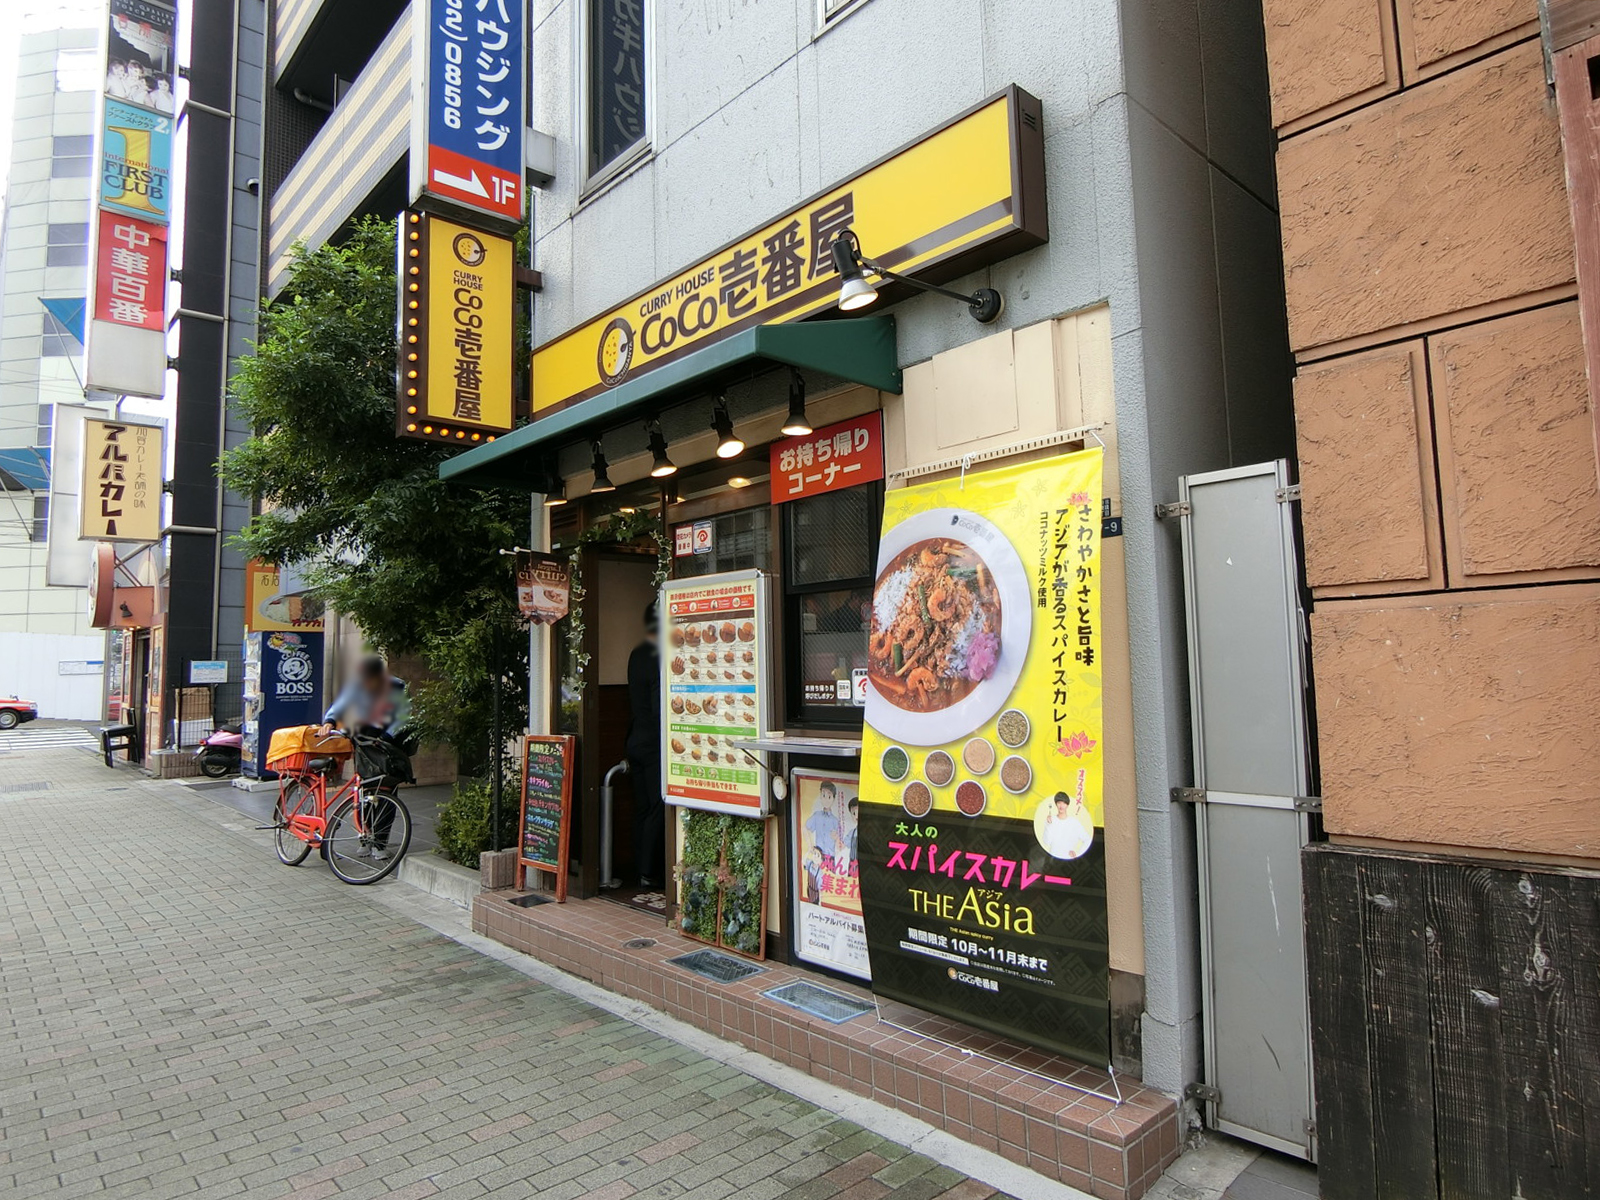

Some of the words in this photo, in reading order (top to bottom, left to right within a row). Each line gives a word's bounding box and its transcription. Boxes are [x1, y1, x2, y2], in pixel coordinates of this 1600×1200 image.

[475, 0, 511, 151] ハウジング
[104, 159, 168, 187] FIRST
[104, 174, 164, 199] CLUB
[491, 175, 516, 205] 1F
[109, 224, 150, 324] 中華百番
[453, 269, 483, 283] CURRY
[453, 276, 483, 291] HOUSE
[639, 288, 674, 318] CURRY
[676, 266, 715, 300] HOUSE
[779, 427, 869, 472] お持ち帰り
[788, 463, 861, 495] コーナー
[1037, 511, 1048, 609] ココナッツミルク使用
[1075, 504, 1095, 667] さわやかさと旨味
[1051, 509, 1068, 743] アジアが香るスパイスカレー
[275, 682, 314, 695] BOSS
[895, 822, 938, 839] 大人の
[886, 841, 1072, 891] スパイスカレー
[908, 888, 954, 920] THE
[977, 888, 1003, 900] アジア
[907, 926, 949, 948] 期間限定
